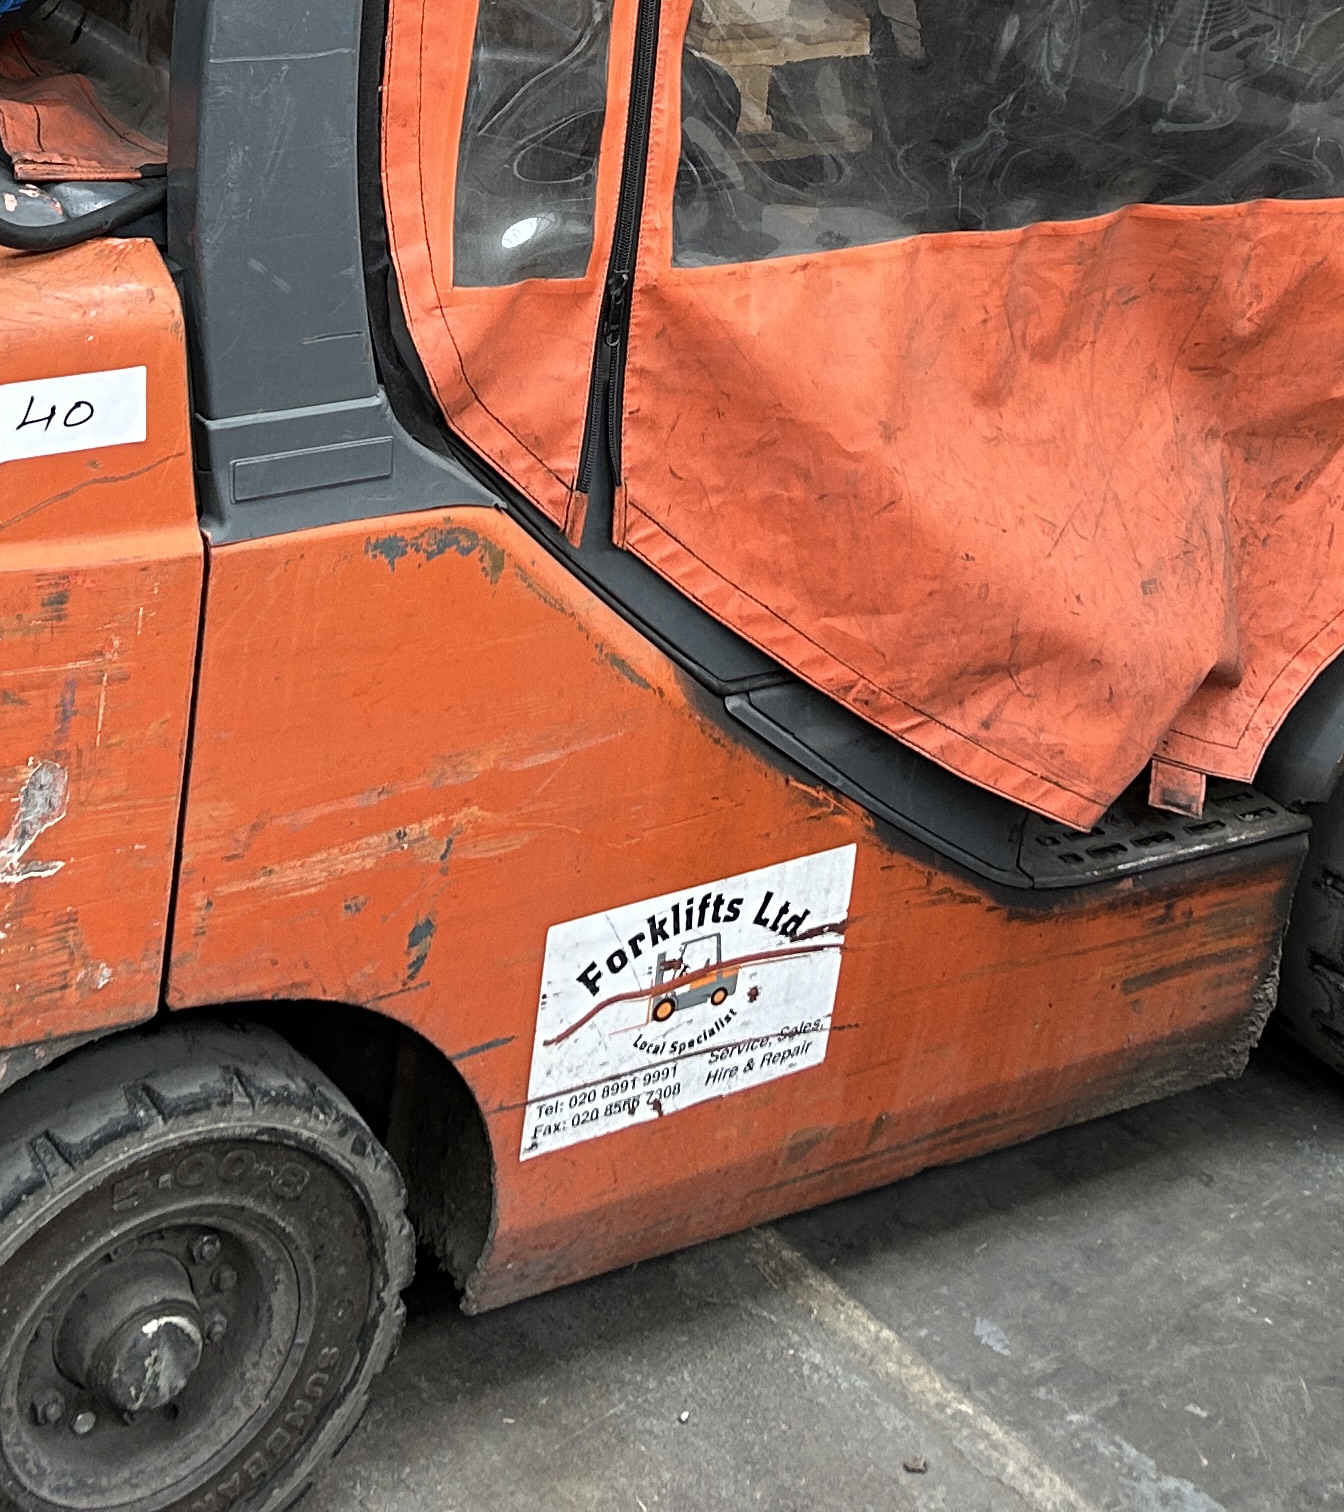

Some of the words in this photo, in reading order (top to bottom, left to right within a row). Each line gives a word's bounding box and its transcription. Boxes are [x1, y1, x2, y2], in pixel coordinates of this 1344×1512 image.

[15, 395, 95, 432] 40
[575, 890, 745, 997] Forklifts
[752, 890, 810, 942] Ltd
[632, 1033, 666, 1056] Local
[670, 1008, 738, 1055] Specialist
[707, 1036, 773, 1065] Service,
[704, 1065, 739, 1087] Hire
[743, 1057, 756, 1075] &
[760, 1041, 814, 1069] Repair
[535, 1100, 565, 1120] Tel:
[568, 1089, 597, 1110] 020
[601, 1076, 637, 1100] 8991
[642, 1064, 678, 1087] 9991
[532, 1120, 566, 1141] Fax:
[570, 1108, 599, 1129] 020
